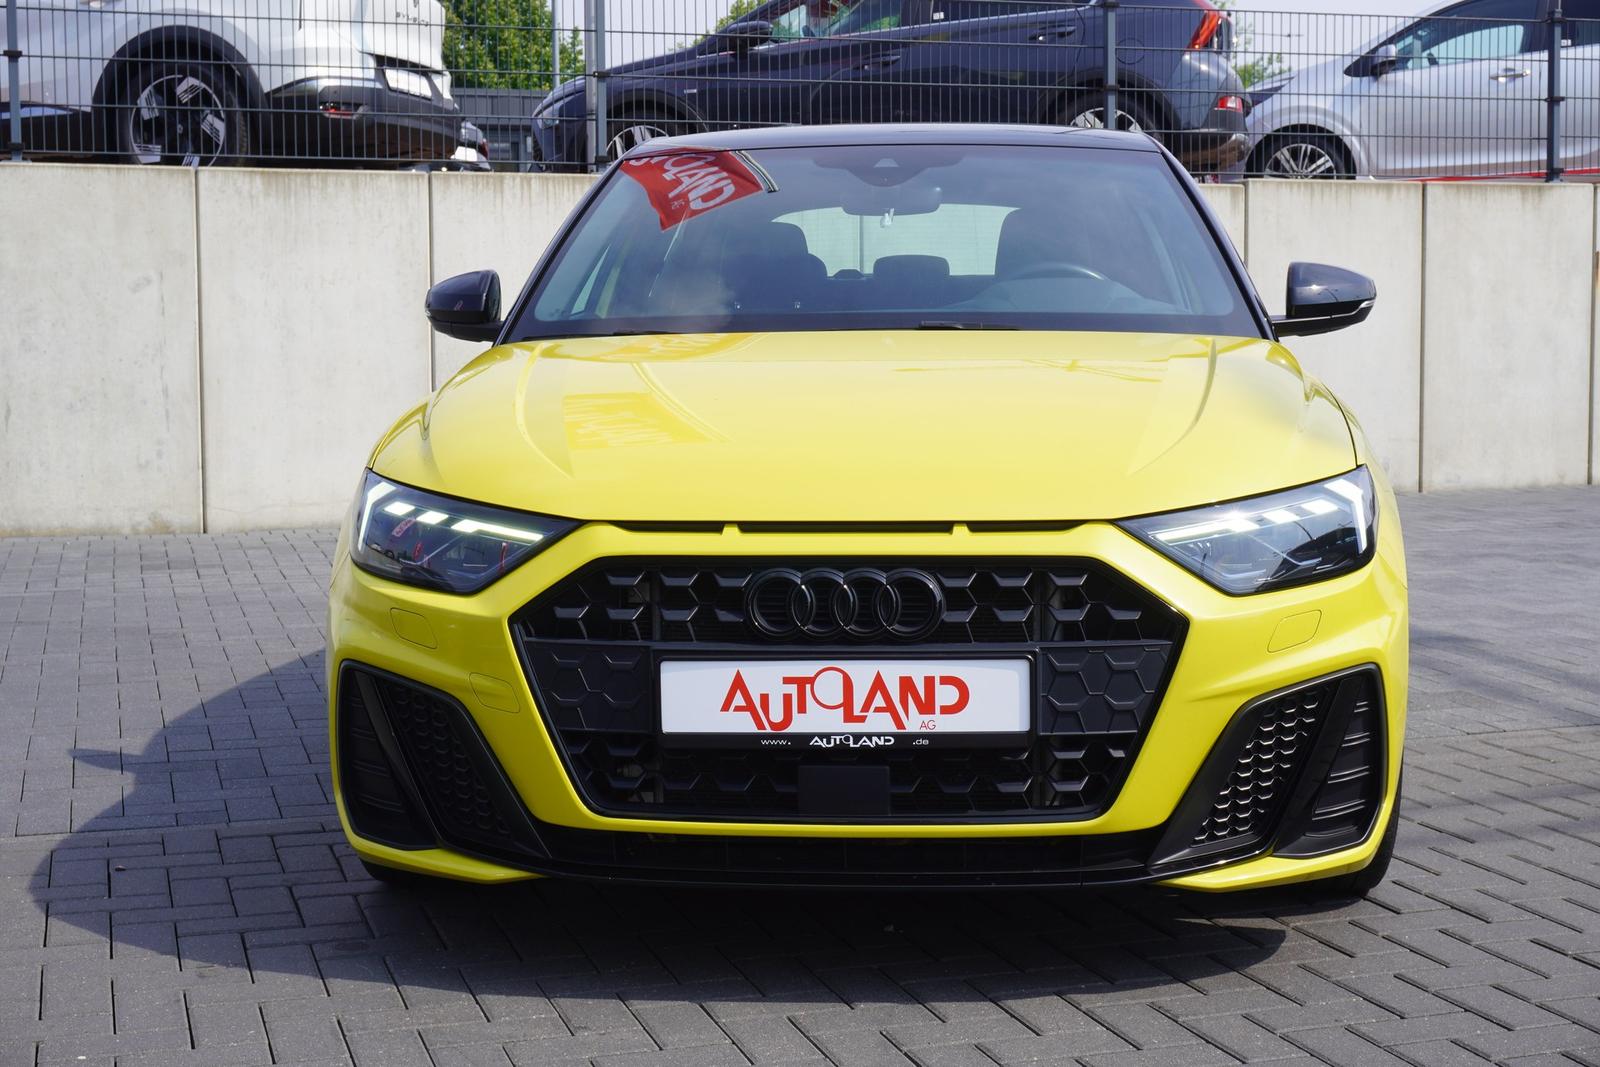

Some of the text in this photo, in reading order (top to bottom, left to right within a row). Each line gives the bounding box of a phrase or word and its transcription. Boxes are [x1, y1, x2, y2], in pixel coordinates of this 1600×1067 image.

[720, 666, 970, 732] AUTOLAND
[919, 719, 937, 731] AG
[809, 734, 895, 748] AUTOLAND
[912, 737, 929, 746] .de
